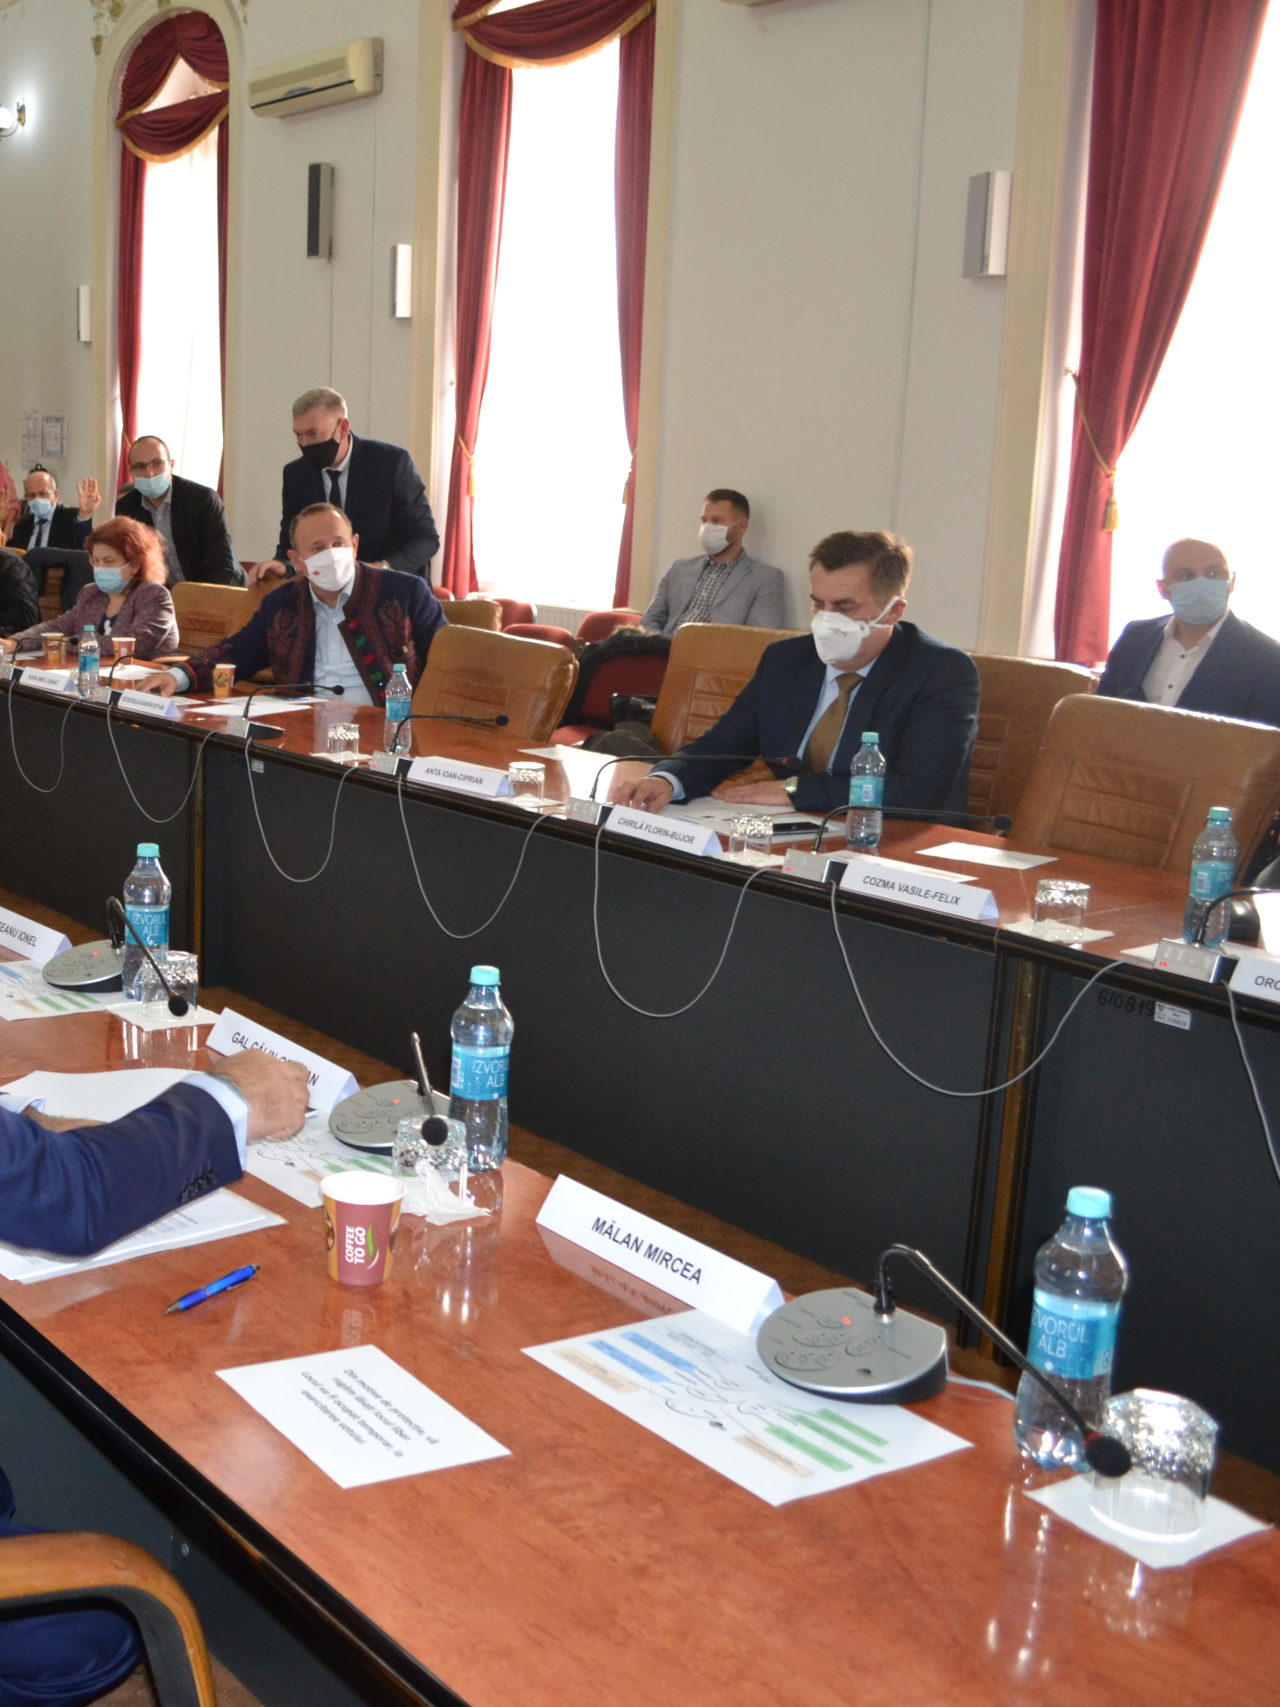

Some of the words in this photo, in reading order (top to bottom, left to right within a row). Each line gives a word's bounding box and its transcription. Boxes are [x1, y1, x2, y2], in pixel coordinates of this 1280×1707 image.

[424, 767, 441, 776] ANTA
[644, 824, 696, 845] FLORIN-BUJOR
[862, 875, 895, 891] COZMA
[898, 882, 962, 906] VASILE-FELIX
[17, 931, 38, 948] IONEL
[231, 1031, 250, 1050] GAL
[345, 1224, 355, 1264] COFFEE
[354, 1226, 366, 1245] GO
[354, 1247, 365, 1264] TO
[591, 1216, 644, 1254] MĂLAN
[643, 1243, 702, 1285] MIRCEA
[1037, 1333, 1066, 1359] ALB
